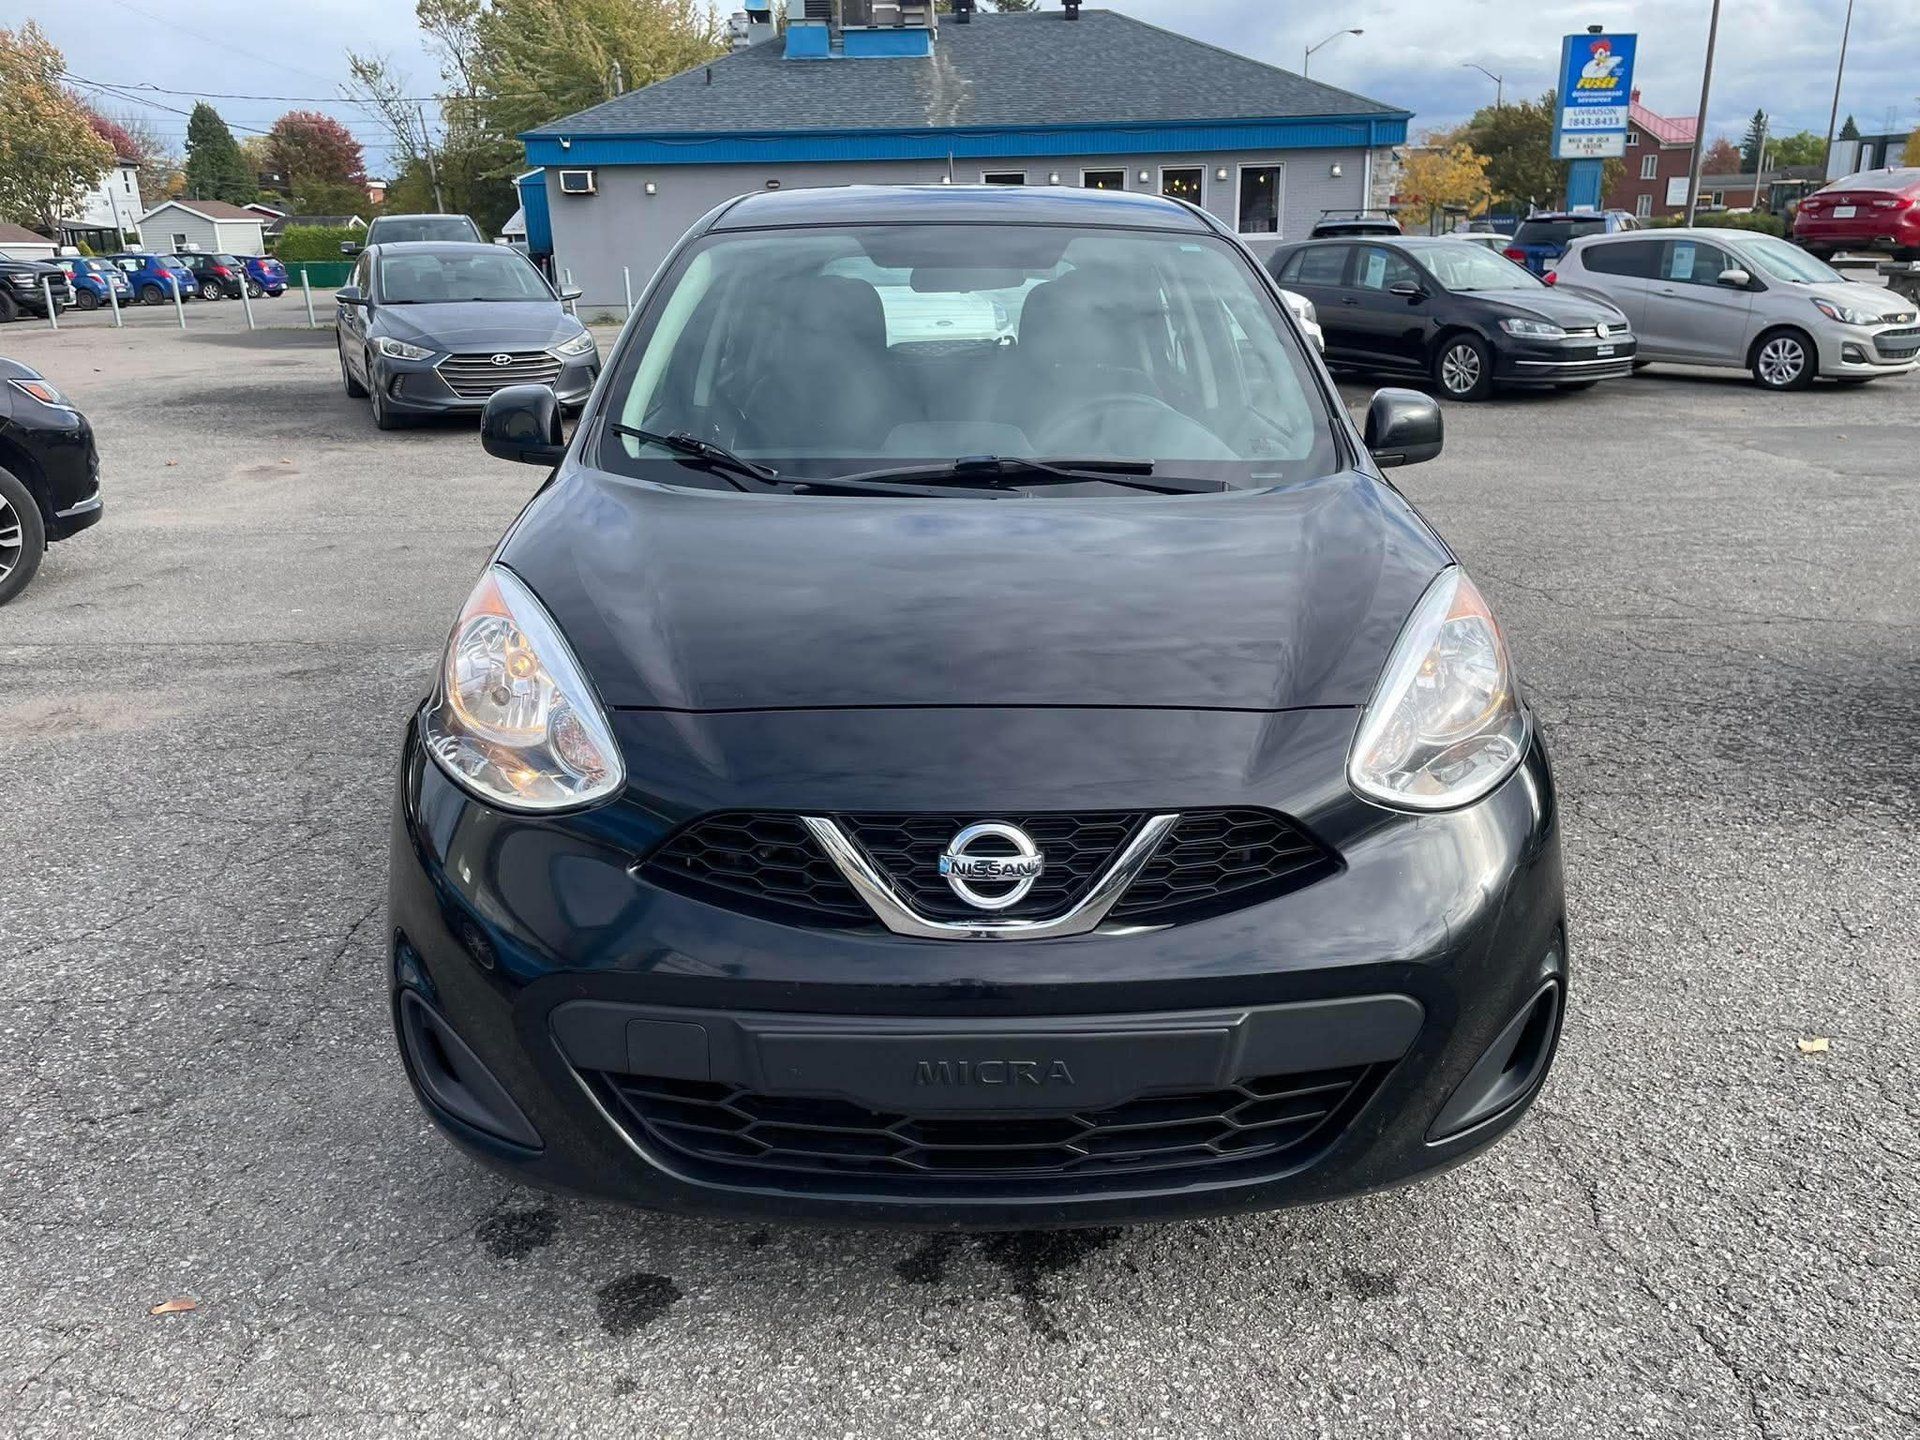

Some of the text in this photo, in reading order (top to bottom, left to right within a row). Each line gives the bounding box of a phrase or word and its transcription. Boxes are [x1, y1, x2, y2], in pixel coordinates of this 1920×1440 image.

[1573, 108, 1617, 116] LIVRAISON
[950, 861, 1032, 877] NISSAN
[914, 1060, 1076, 1085] MICRA
